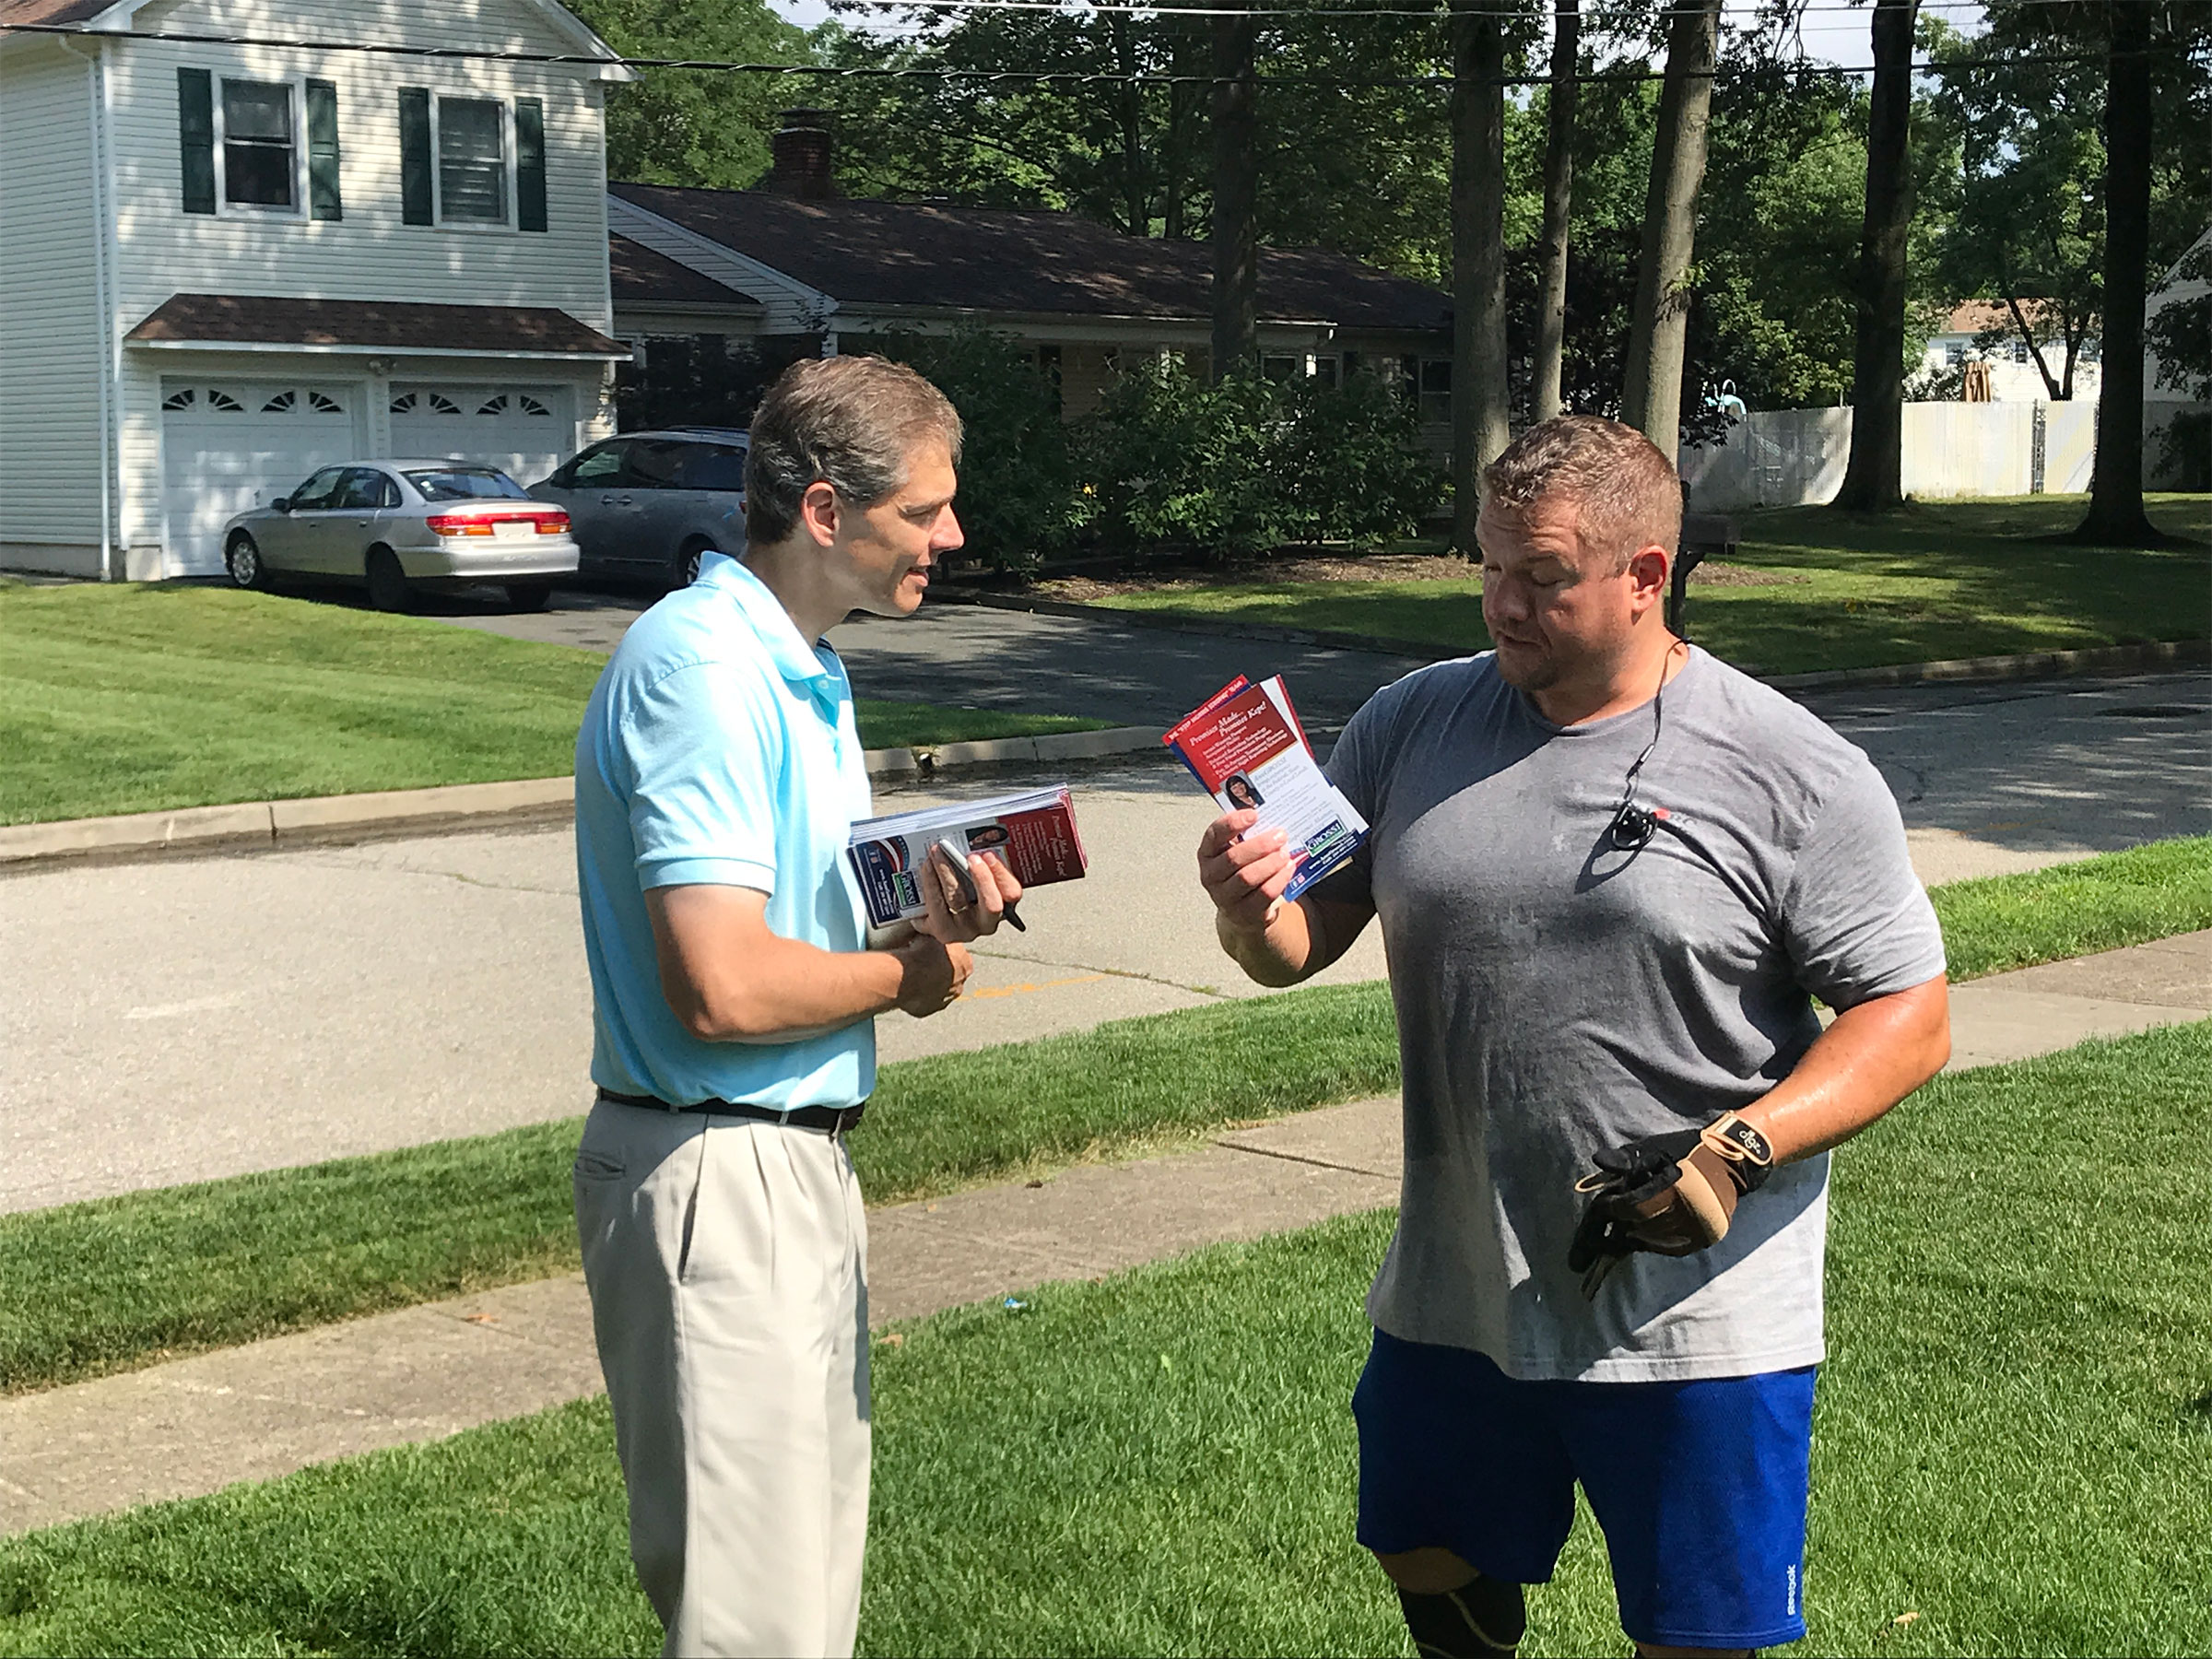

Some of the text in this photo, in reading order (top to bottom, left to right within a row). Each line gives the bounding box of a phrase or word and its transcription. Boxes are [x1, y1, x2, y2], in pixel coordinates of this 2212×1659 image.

[1218, 716, 1248, 736] Promises
[1246, 700, 1268, 719] Kept!
[1189, 726, 1218, 746] Promises
[1306, 822, 1341, 850] GROSSI
[900, 872, 915, 904] GROSSI
[1786, 1564, 1797, 1616] Reebok
